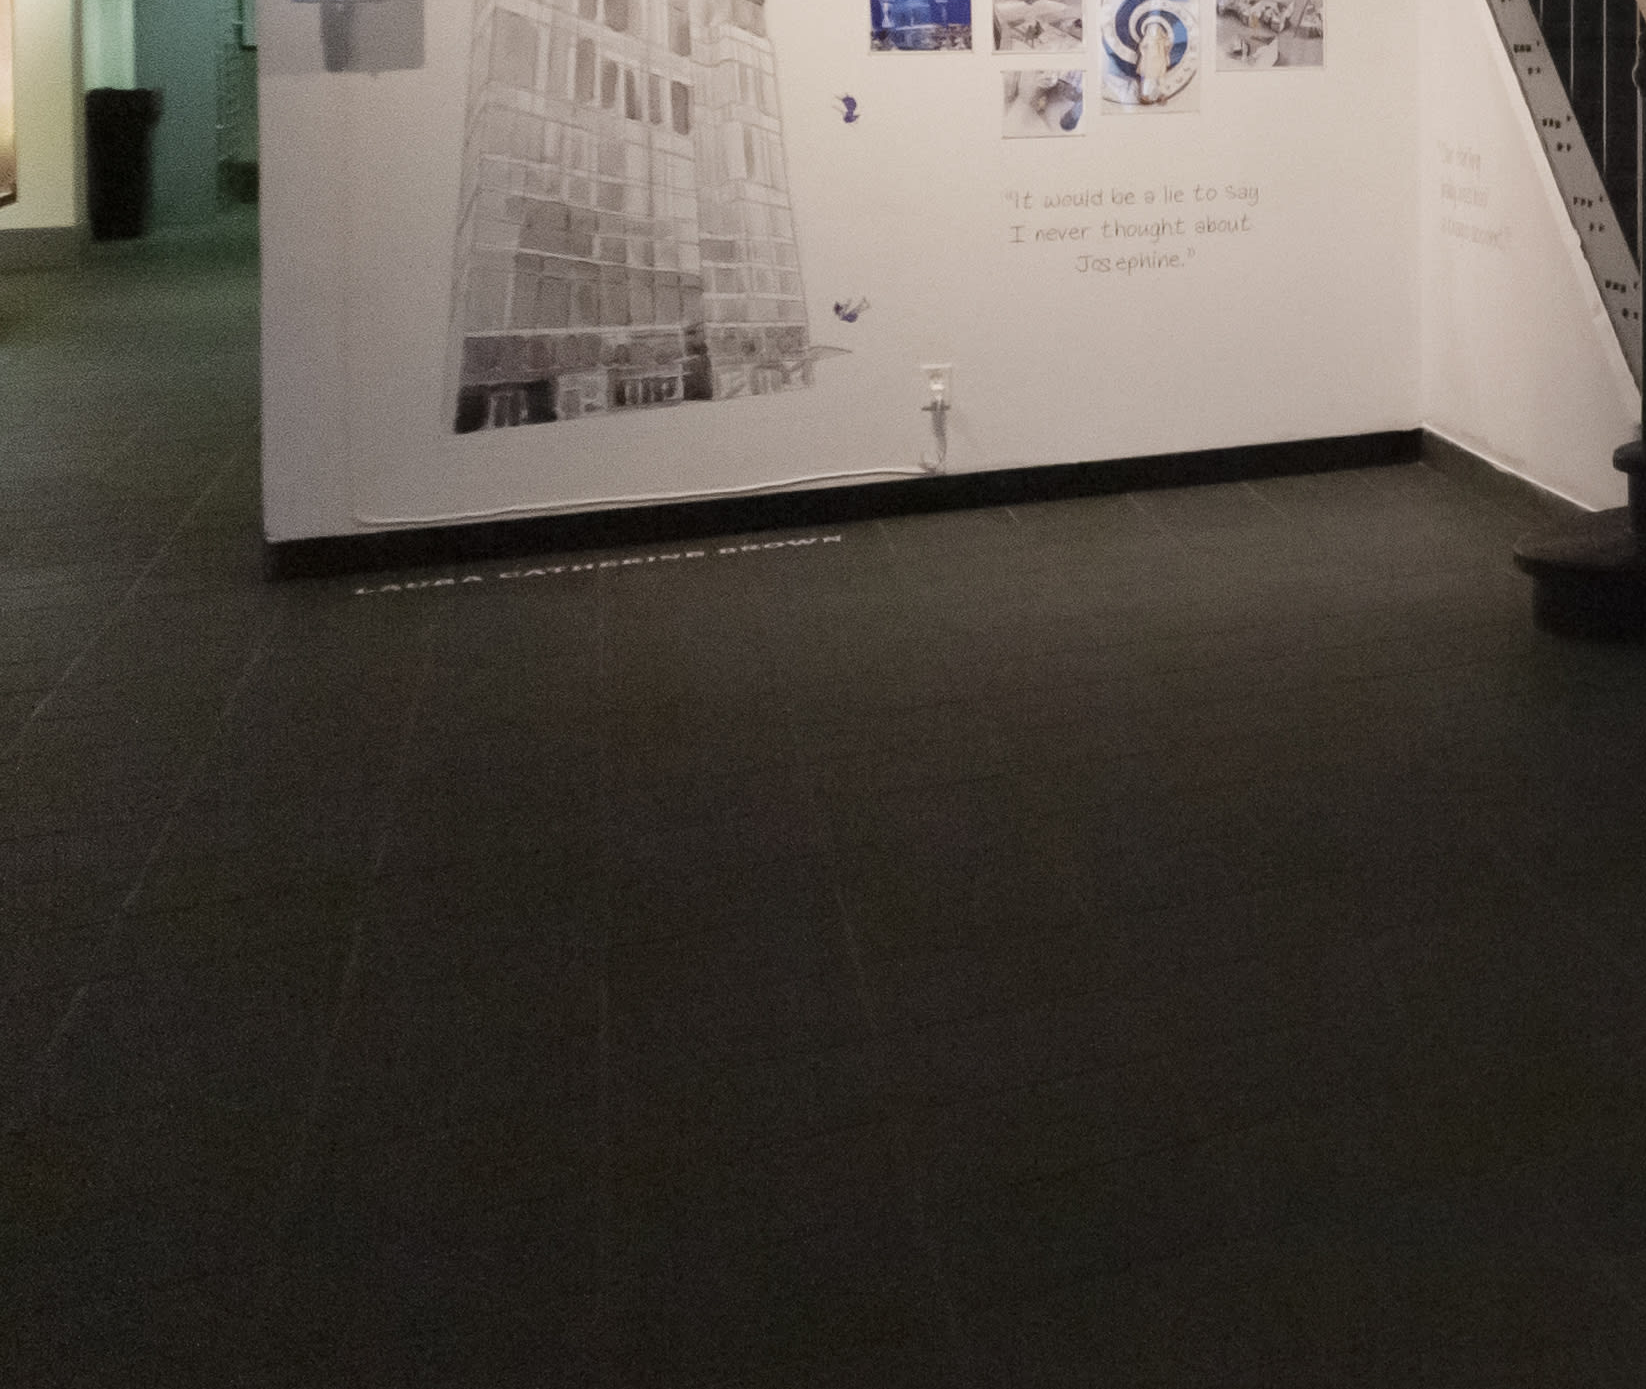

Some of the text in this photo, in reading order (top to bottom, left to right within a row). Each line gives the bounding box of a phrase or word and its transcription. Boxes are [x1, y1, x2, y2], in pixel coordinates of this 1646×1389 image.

[1044, 188, 1103, 209] would
[1112, 188, 1135, 206] be
[1144, 191, 1156, 205] a
[1164, 185, 1185, 205] lie
[1193, 183, 1217, 202] to
[1010, 214, 1253, 244] I never thought about
[719, 534, 842, 554] BROWN
